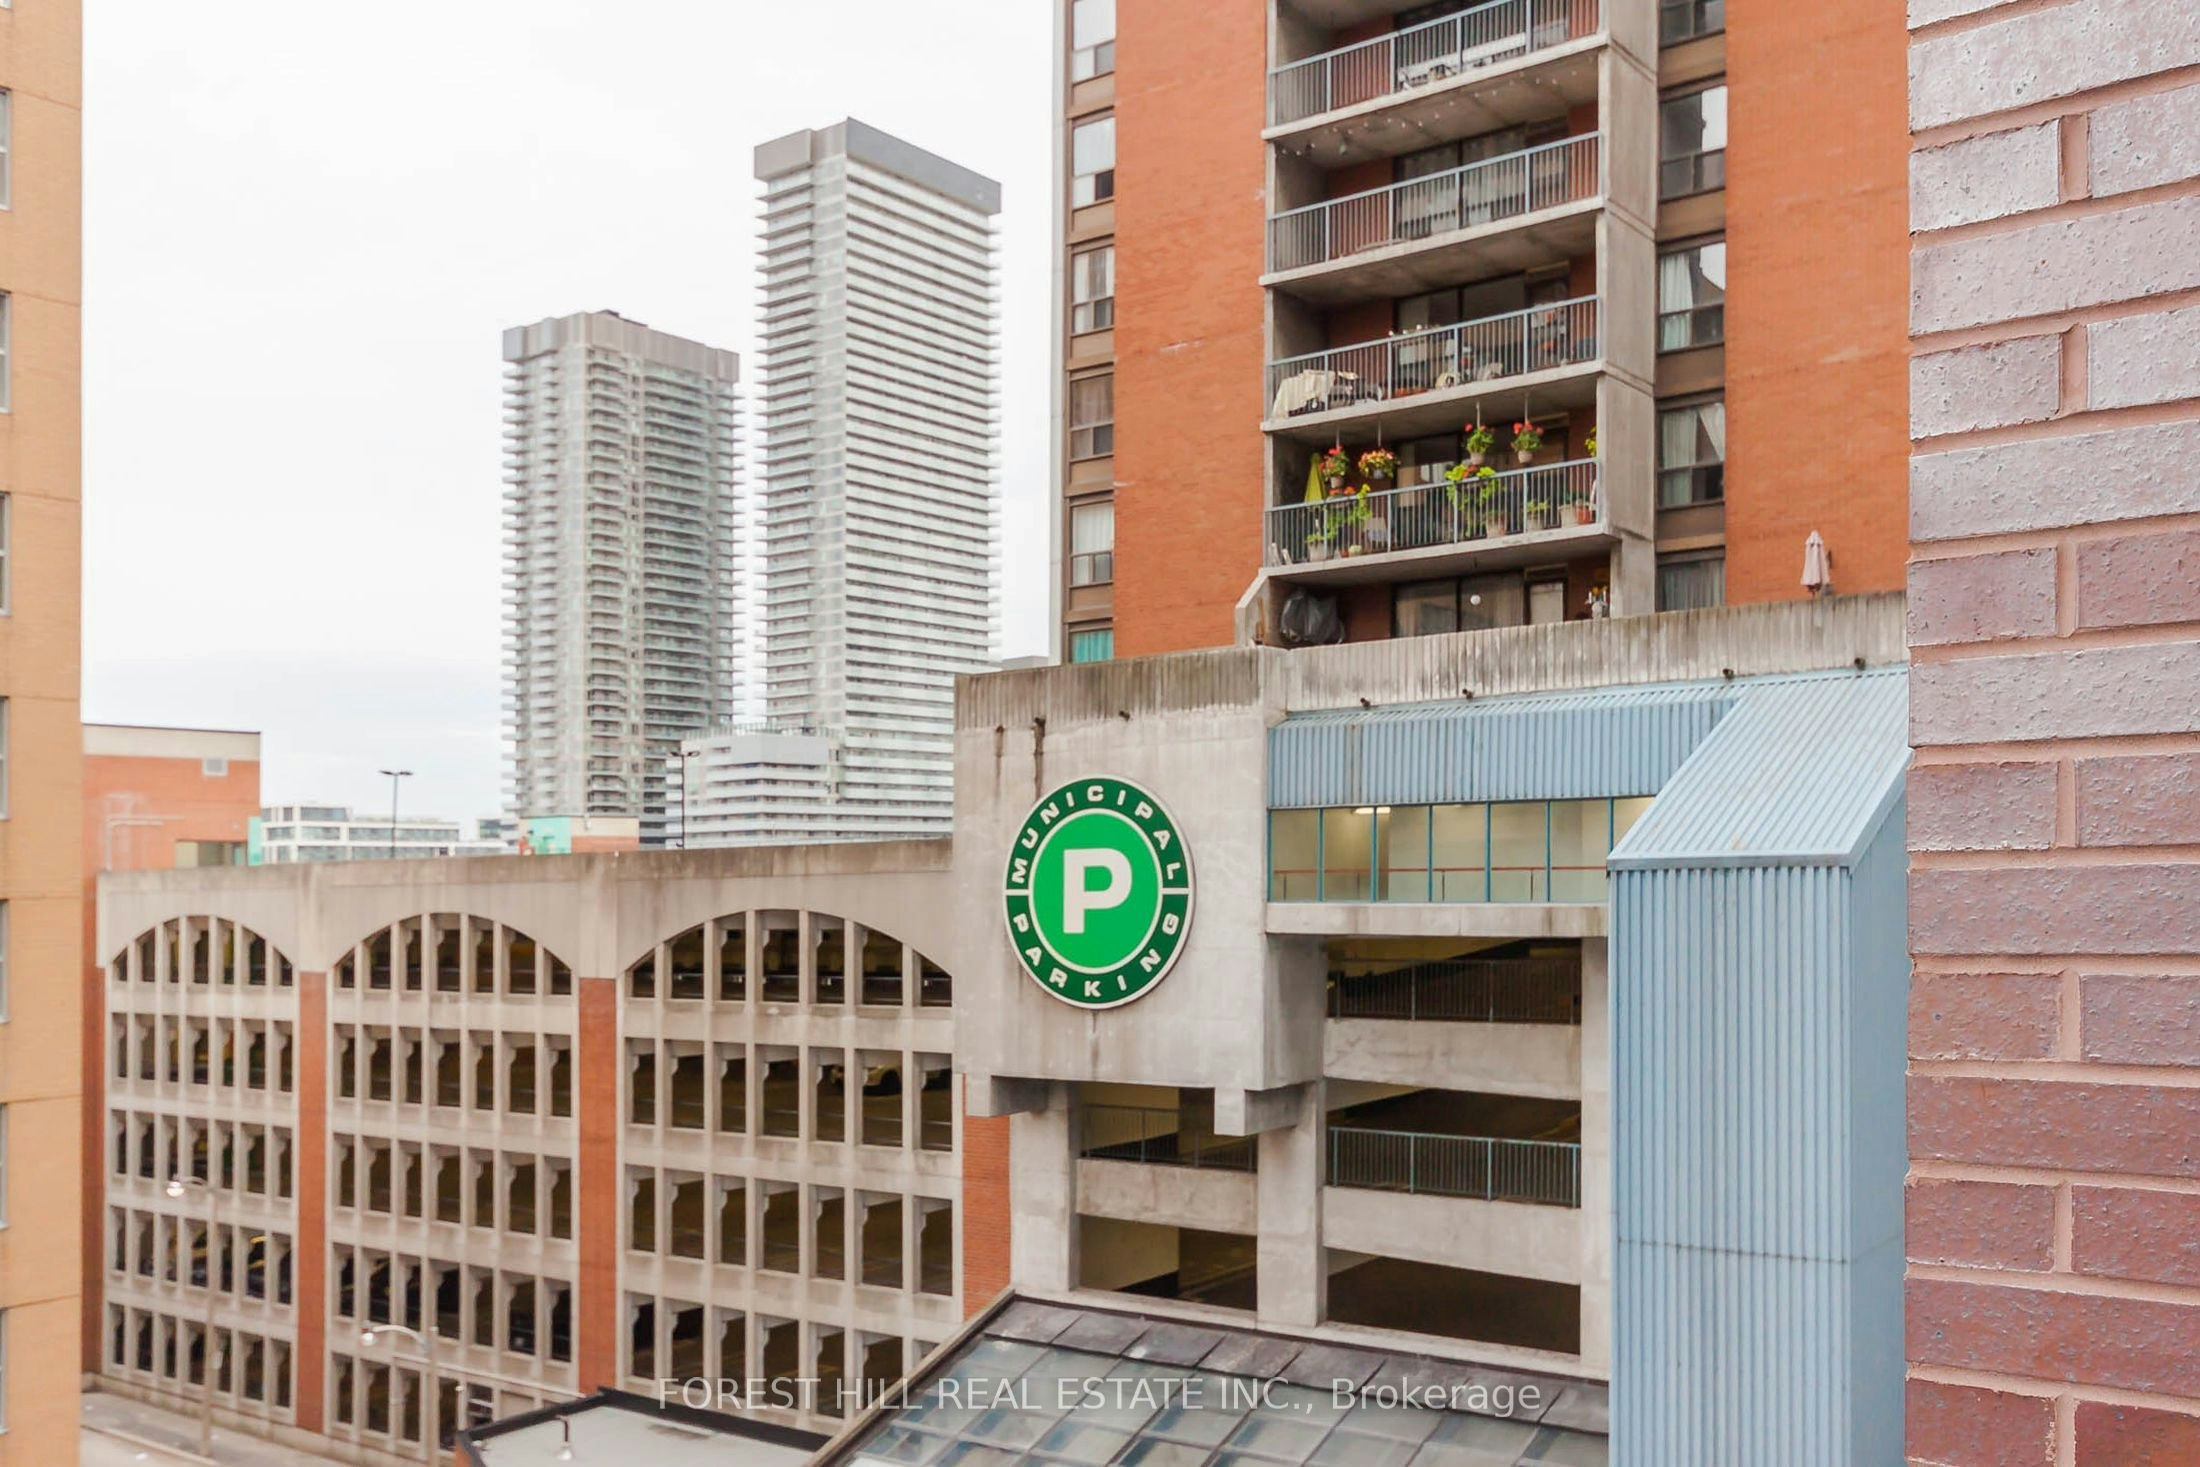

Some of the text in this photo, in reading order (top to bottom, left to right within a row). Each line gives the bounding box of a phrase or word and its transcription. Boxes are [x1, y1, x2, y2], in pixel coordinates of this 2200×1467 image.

[1011, 785, 1181, 884] MUNICIPAL
[1062, 847, 1133, 934] P
[1013, 913, 1180, 998] PARKING
